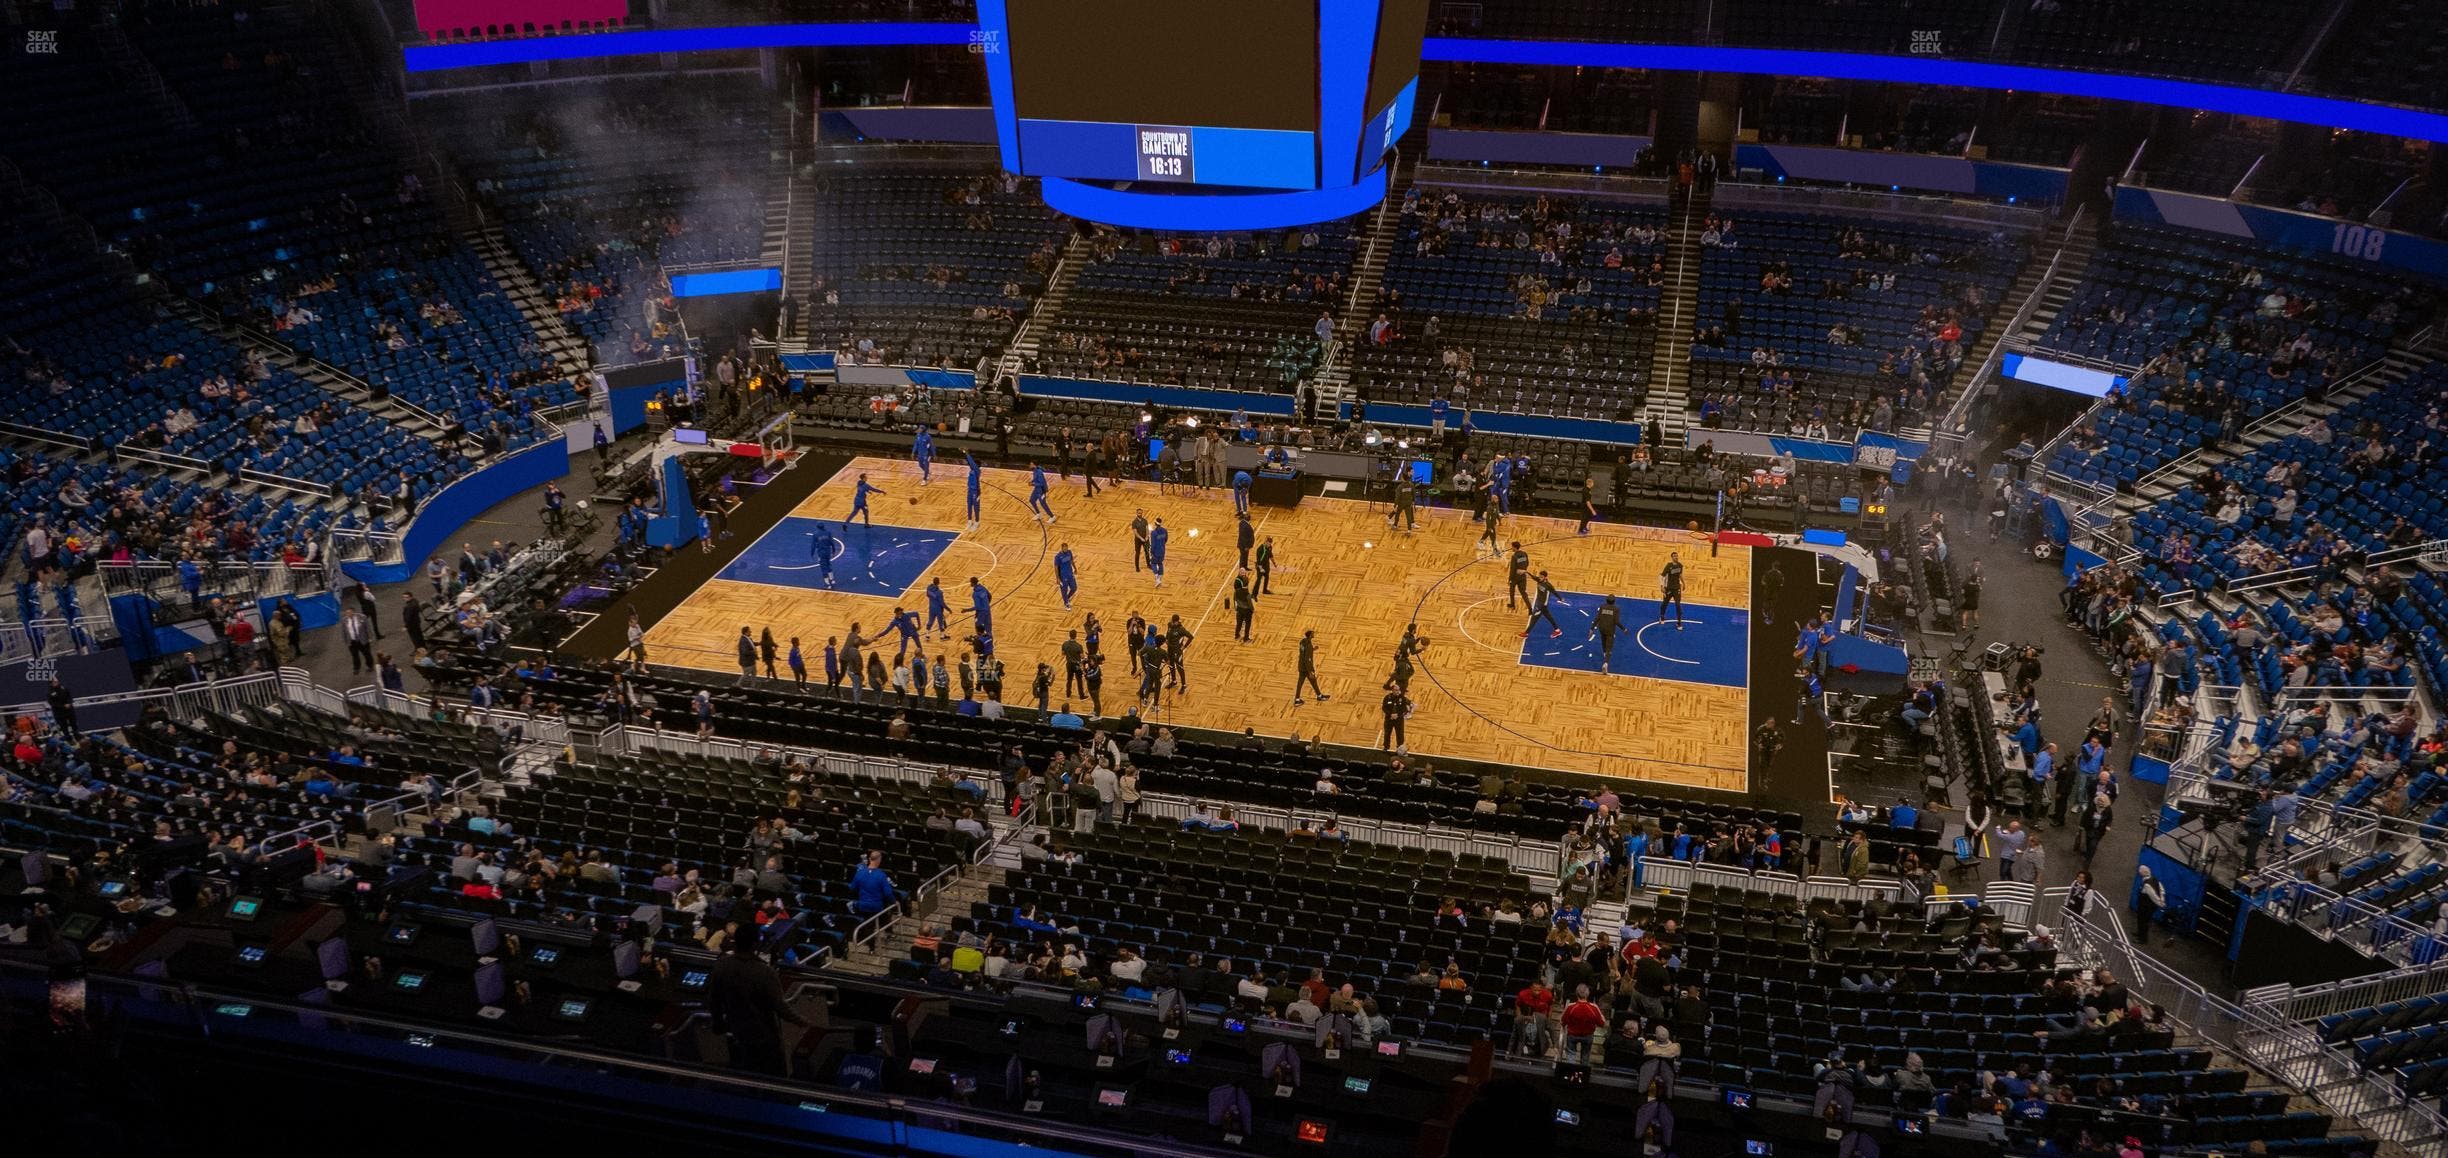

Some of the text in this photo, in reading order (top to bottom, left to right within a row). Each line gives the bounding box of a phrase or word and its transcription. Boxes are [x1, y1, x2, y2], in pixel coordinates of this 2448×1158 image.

[1141, 131, 1179, 142] COUNTDOWN
[1142, 141, 1188, 156] GAMETIME
[2331, 223, 2386, 262] 108
